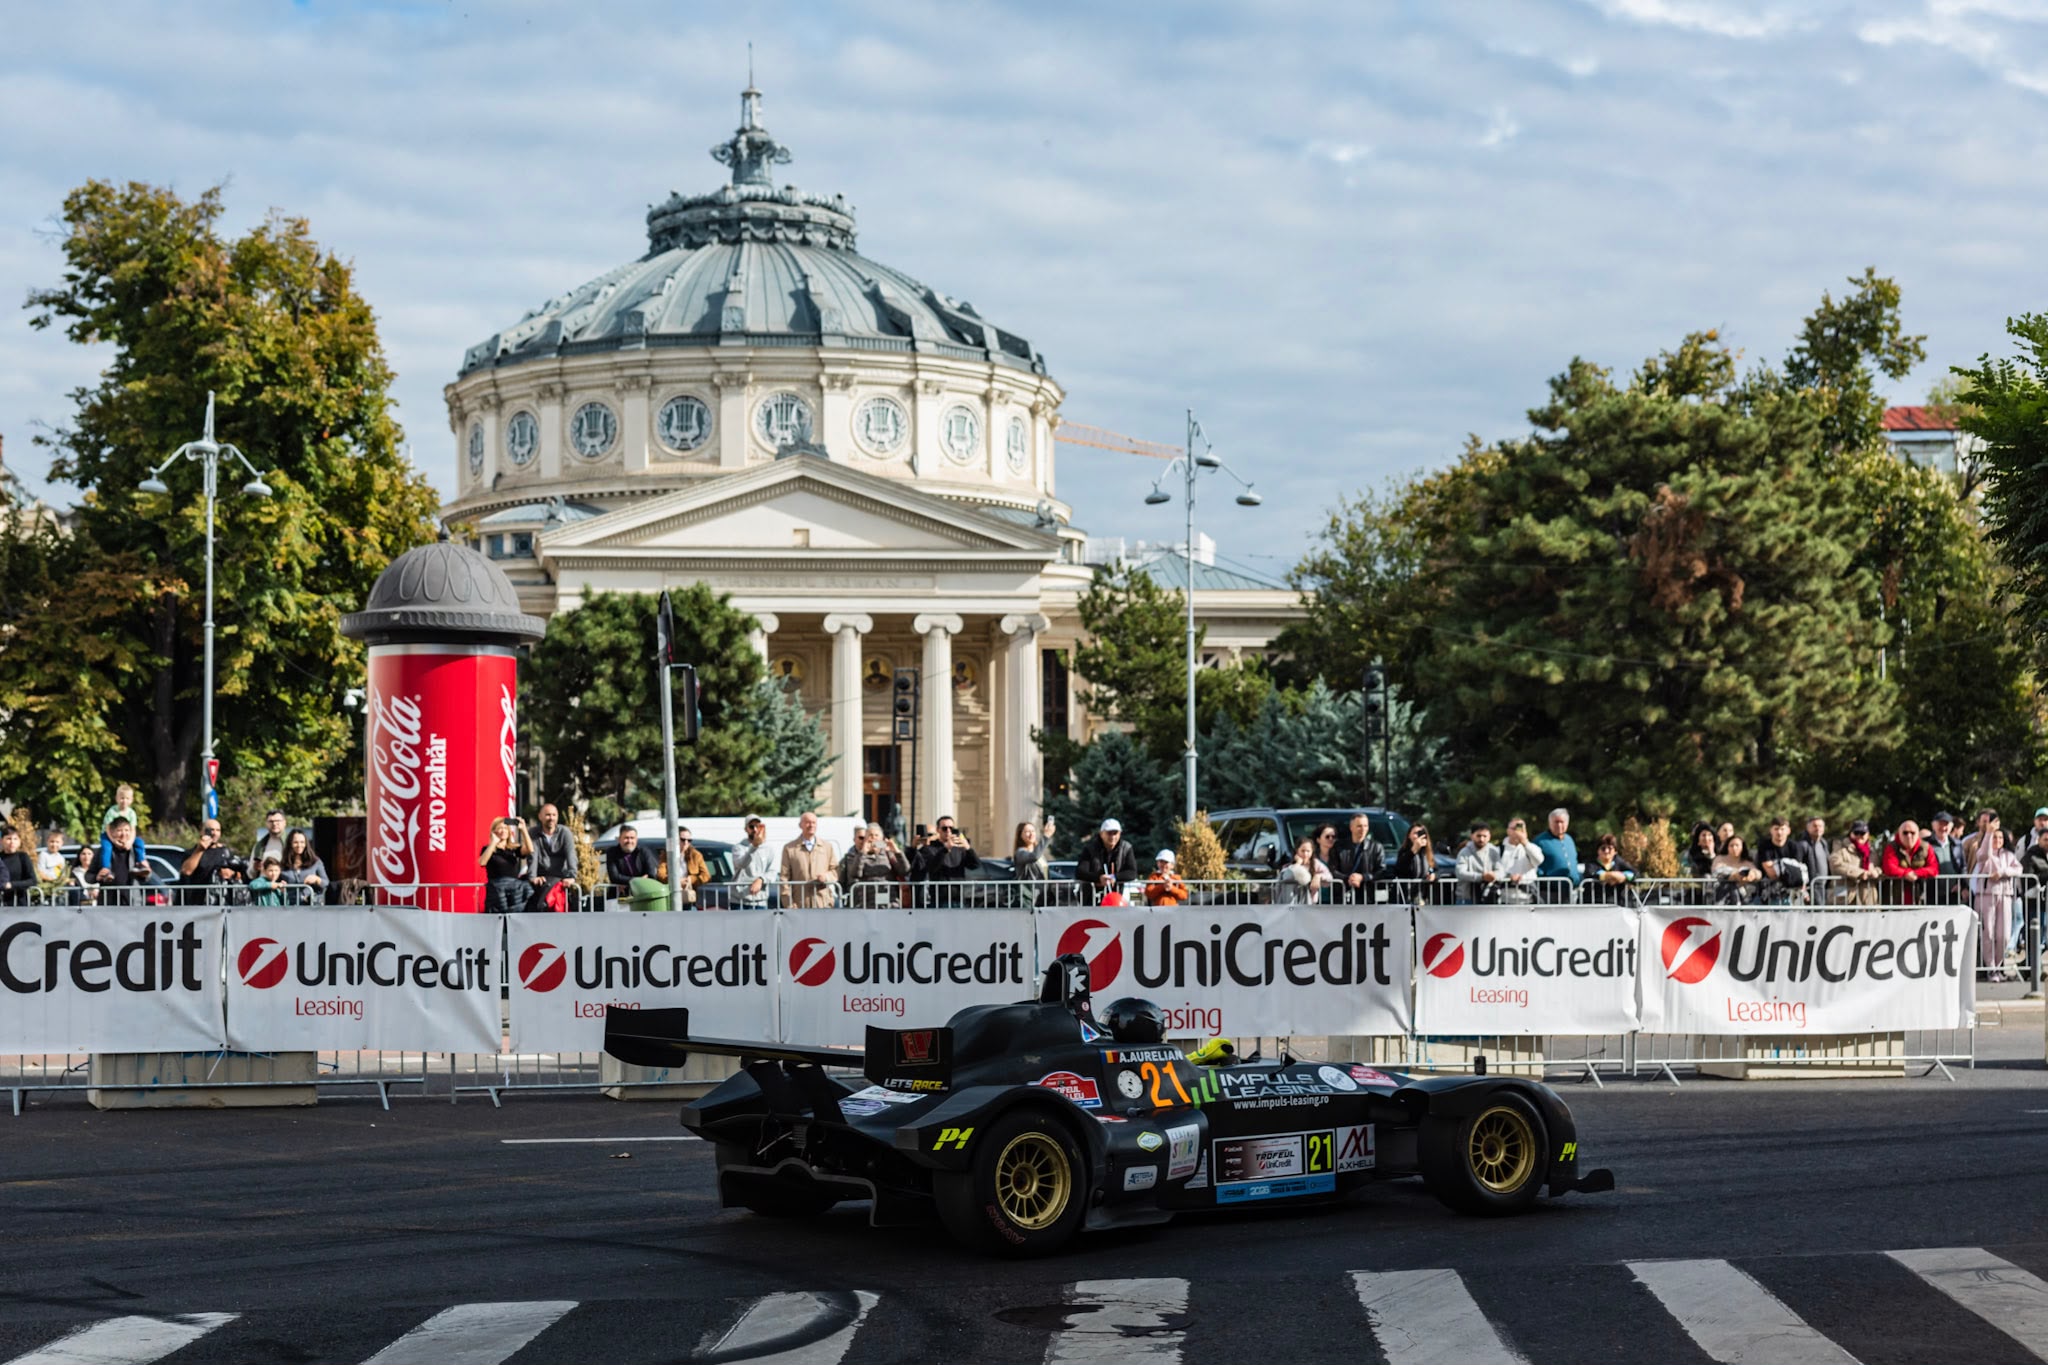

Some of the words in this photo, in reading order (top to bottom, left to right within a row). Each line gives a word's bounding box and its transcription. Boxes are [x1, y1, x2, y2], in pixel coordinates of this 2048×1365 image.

[424, 733, 447, 799] zahăr
[372, 686, 422, 898] Coca-Cola
[428, 800, 447, 852] zero
[0, 920, 202, 994] Credit
[297, 940, 490, 992] UniCredit
[574, 943, 768, 990] UniCredit
[842, 940, 1024, 985] UniCredit
[1132, 921, 1391, 988] UniCredit
[1471, 936, 1636, 978] UniCredit
[1727, 919, 1959, 983] UniCredit
[295, 997, 364, 1021] Leasing
[842, 993, 905, 1017] Leasing
[1469, 984, 1529, 1008] Leasing
[1726, 996, 1807, 1028] Leasing
[1161, 1001, 1222, 1037] asing
[1118, 1050, 1184, 1063] A.AURELIAN
[1140, 1061, 1192, 1108] 21
[1220, 1073, 1315, 1087] IMPULS
[1223, 1084, 1333, 1099] LEASING
[1234, 1094, 1330, 1109] www.impuls-leasing.ro
[932, 1127, 975, 1151] P1
[1255, 1150, 1295, 1161] TROFEUL
[1308, 1134, 1332, 1171] 21
[1266, 1159, 1292, 1169] UniCredit
[1339, 1158, 1375, 1170] AXHELL
